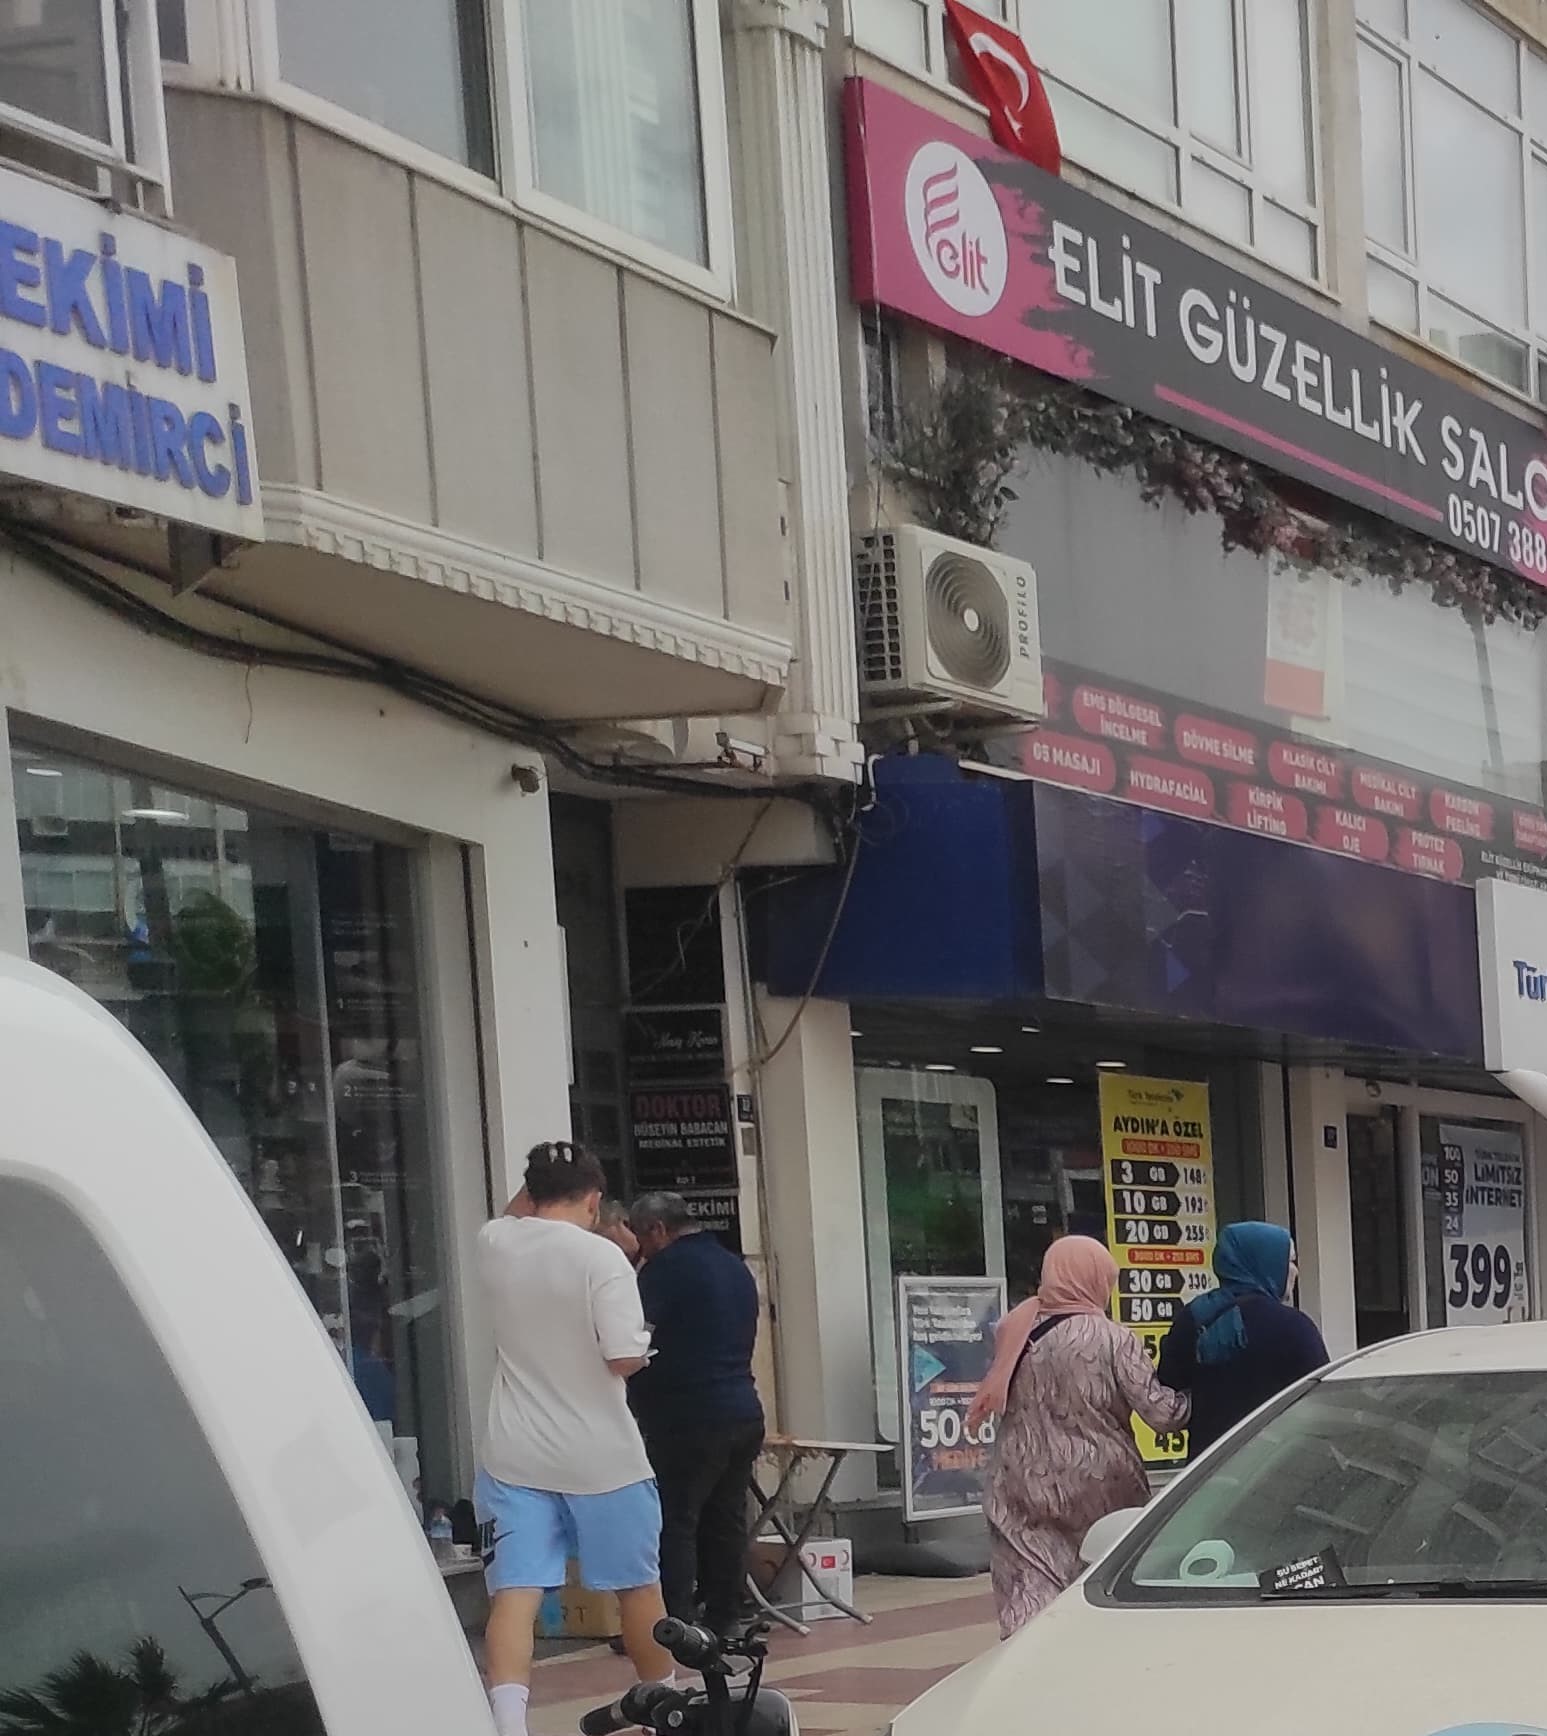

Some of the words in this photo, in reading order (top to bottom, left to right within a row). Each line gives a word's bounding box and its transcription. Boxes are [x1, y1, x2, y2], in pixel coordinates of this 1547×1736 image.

[1048, 219, 1162, 338] ELİT
[1179, 288, 1427, 466] GÜZELLİK
[0, 350, 253, 506] DEMİRCİ
[1449, 493, 1501, 553] 0507
[1053, 746, 1101, 777] MASAJI
[1221, 738, 1255, 766] SİLME
[634, 1094, 722, 1120] DOKTOR
[1113, 1114, 1170, 1137] AYDIN'A
[1121, 1160, 1134, 1184] 3
[1443, 1169, 1460, 1185] 50
[1121, 1190, 1146, 1215] 10
[1444, 1191, 1460, 1207] 35
[1125, 1219, 1150, 1244] 20
[1444, 1215, 1460, 1231] 24
[1129, 1269, 1152, 1293] 30
[1448, 1243, 1512, 1310] 399
[1130, 1298, 1153, 1322] 50
[920, 1409, 961, 1449] 50
